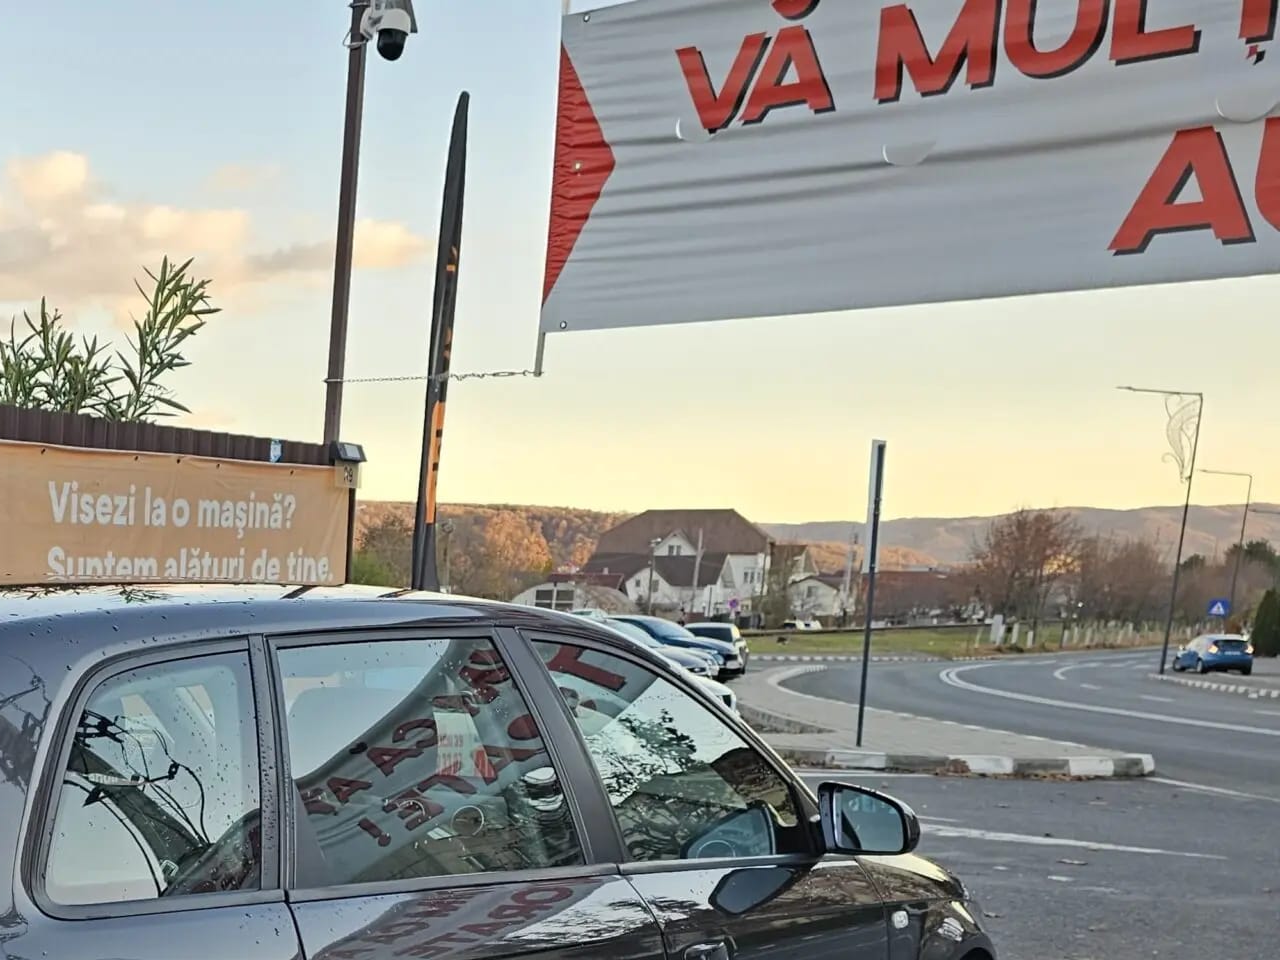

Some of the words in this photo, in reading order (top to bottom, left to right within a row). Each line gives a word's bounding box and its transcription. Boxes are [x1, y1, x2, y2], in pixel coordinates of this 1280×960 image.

[675, 0, 835, 134] VĂ
[1107, 117, 1280, 256] A
[48, 481, 135, 526] Visezi
[144, 487, 166, 527] la
[172, 497, 190, 527] o
[197, 493, 297, 539] mașină?
[47, 546, 158, 580] Suntem
[164, 547, 245, 582] alături
[251, 548, 281, 582] de
[286, 546, 334, 583] tine.
